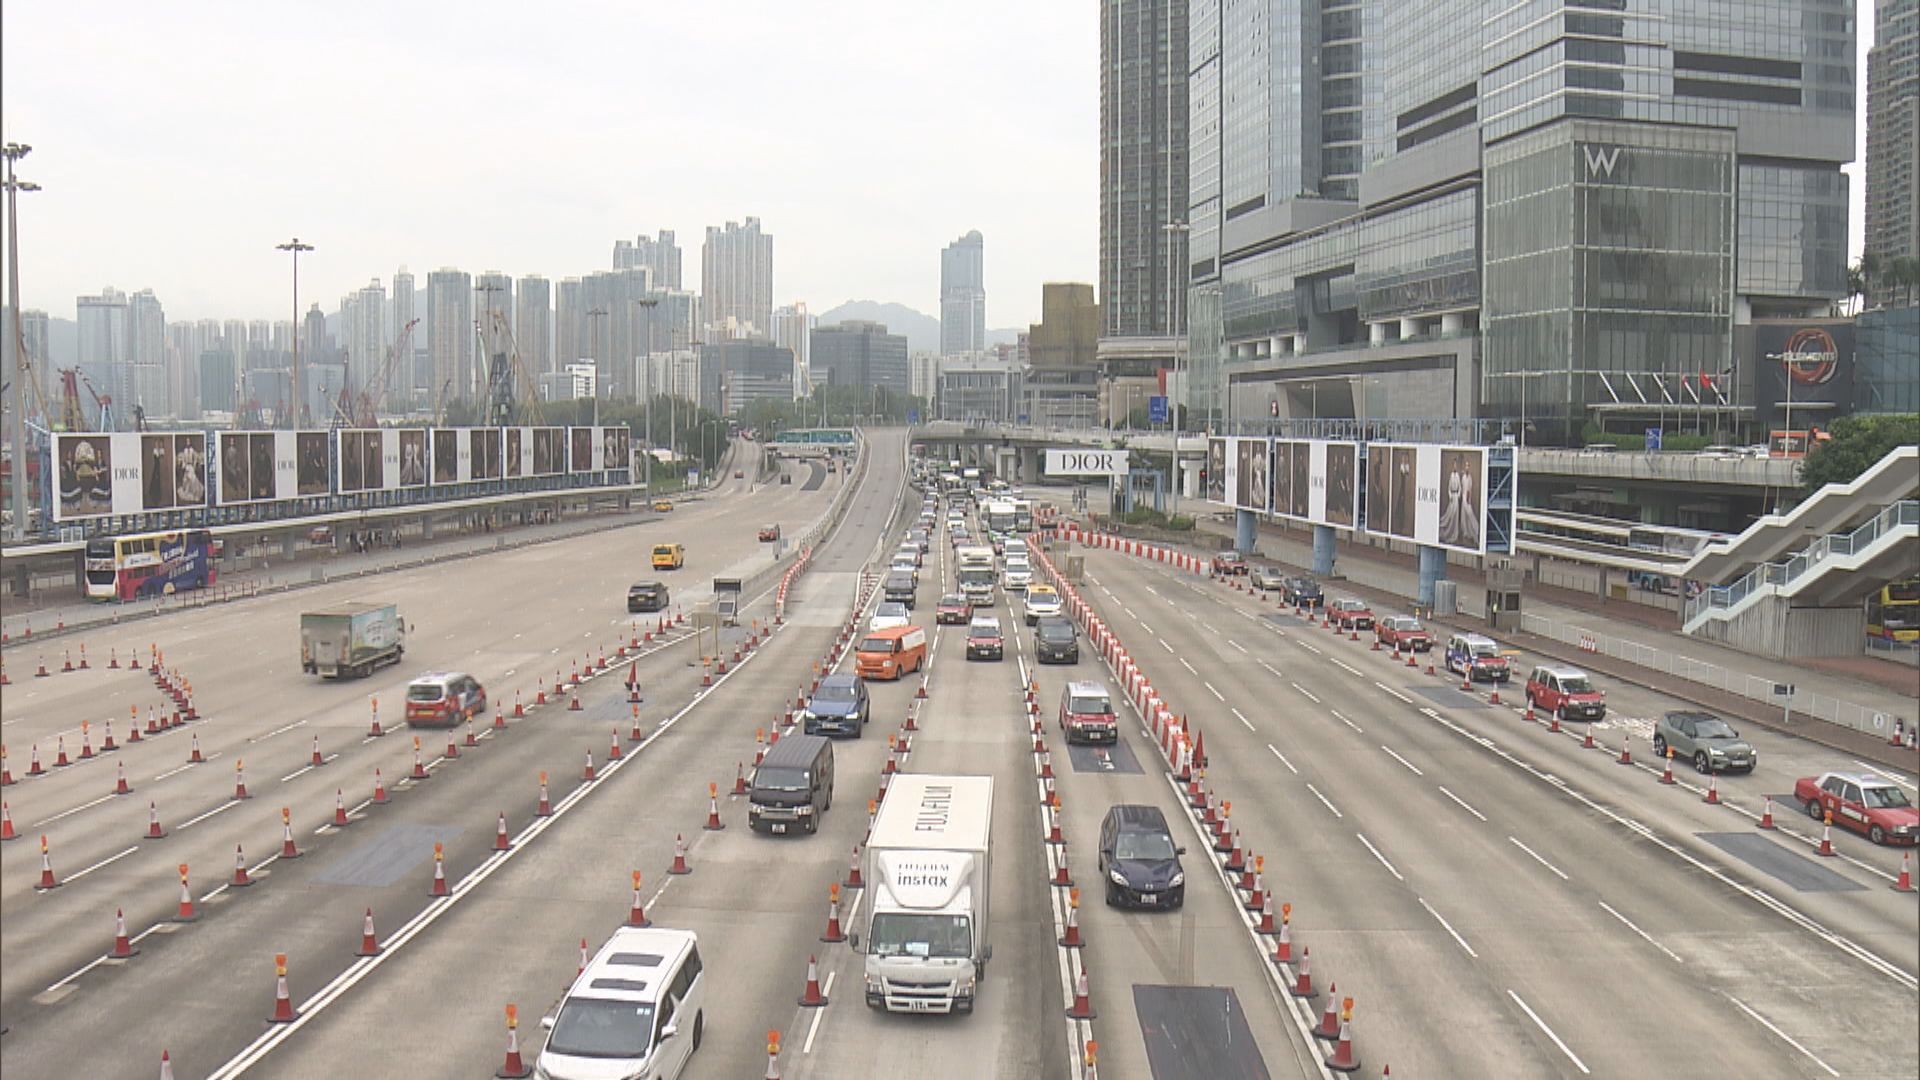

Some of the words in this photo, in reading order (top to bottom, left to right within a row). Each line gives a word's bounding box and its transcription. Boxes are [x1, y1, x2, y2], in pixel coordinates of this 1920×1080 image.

[1583, 146, 1621, 177] W
[1783, 352, 1835, 361] ELEMENTS
[1062, 454, 1114, 471] DIOR
[114, 467, 139, 481] DIOR
[1418, 487, 1437, 503] DIOR
[897, 872, 948, 887] instax
